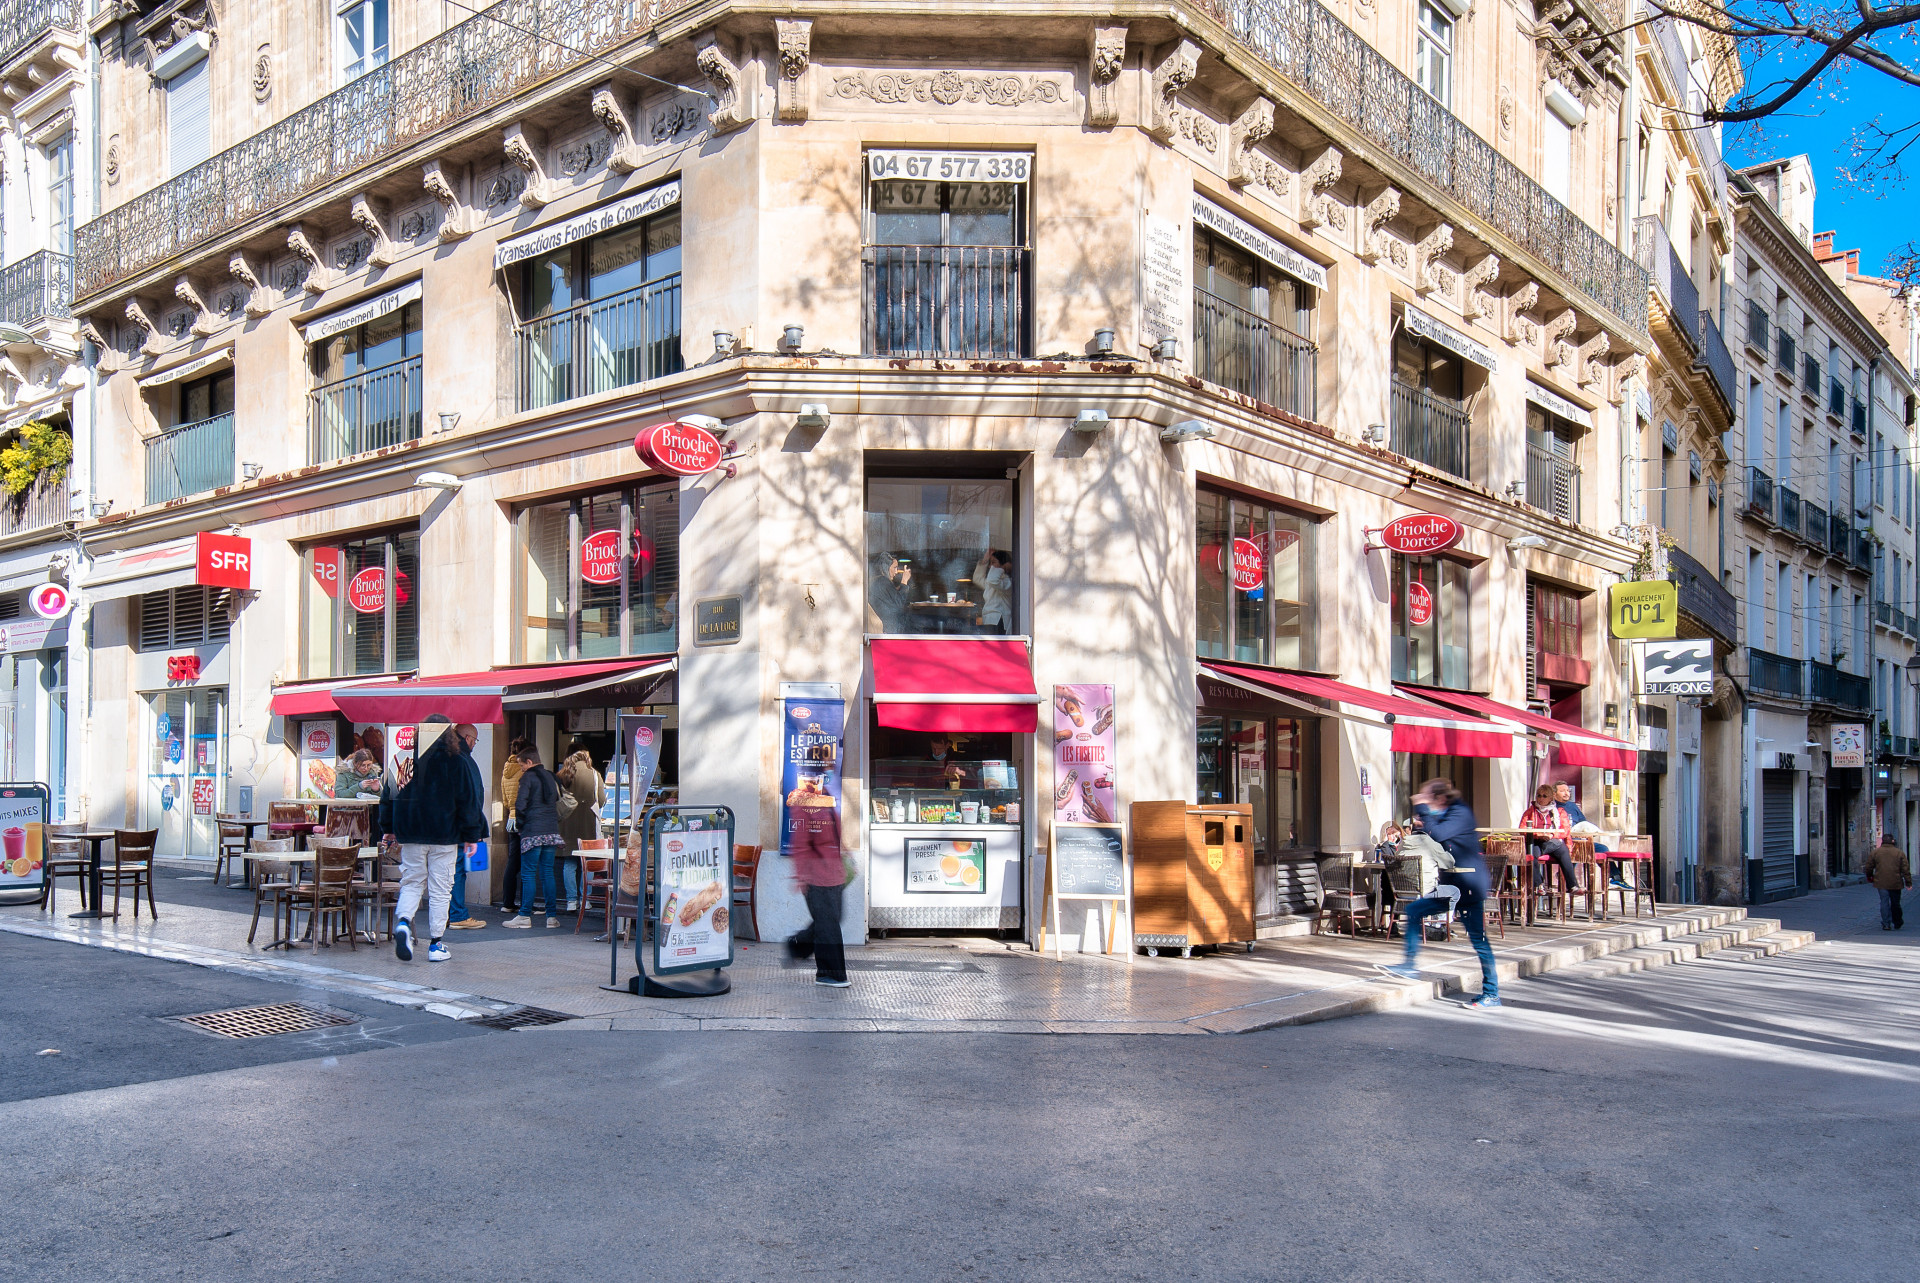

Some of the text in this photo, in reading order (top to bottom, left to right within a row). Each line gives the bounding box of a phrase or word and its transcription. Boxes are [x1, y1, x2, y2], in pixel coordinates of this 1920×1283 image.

[872, 155, 1027, 178] 04 67 577 338
[497, 231, 562, 264] Transactions
[564, 216, 598, 243] Fonds
[600, 211, 614, 230] de
[616, 189, 678, 225] Commerce
[321, 306, 374, 335] Emplacement
[1536, 388, 1566, 413] Emplacement
[661, 428, 714, 455] Brioche
[668, 449, 706, 468] Dorée
[1394, 518, 1448, 537] Brioche
[585, 536, 621, 562] Brioc
[1399, 536, 1439, 549] Dorée
[210, 549, 249, 572] SFR
[1233, 546, 1261, 570] rioche
[355, 572, 385, 594] Brioch
[1410, 588, 1429, 607] rioche
[1620, 593, 1666, 604] EMPLACEMENT
[712, 605, 724, 614] RUE
[699, 621, 738, 634] DE LA LOGE
[167, 655, 200, 681] SFR
[398, 737, 415, 747] Doré
[399, 729, 415, 737] Brioch
[790, 734, 837, 749] LE PLAISIR
[310, 740, 329, 749] Dorée
[790, 742, 837, 760] EST ROI
[1062, 745, 1105, 762] LES FUSETTES
[1779, 752, 1796, 770] BASIC
[197, 783, 214, 802] 5G
[13, 805, 39, 819] MIXES
[671, 846, 720, 870] FORMULE
